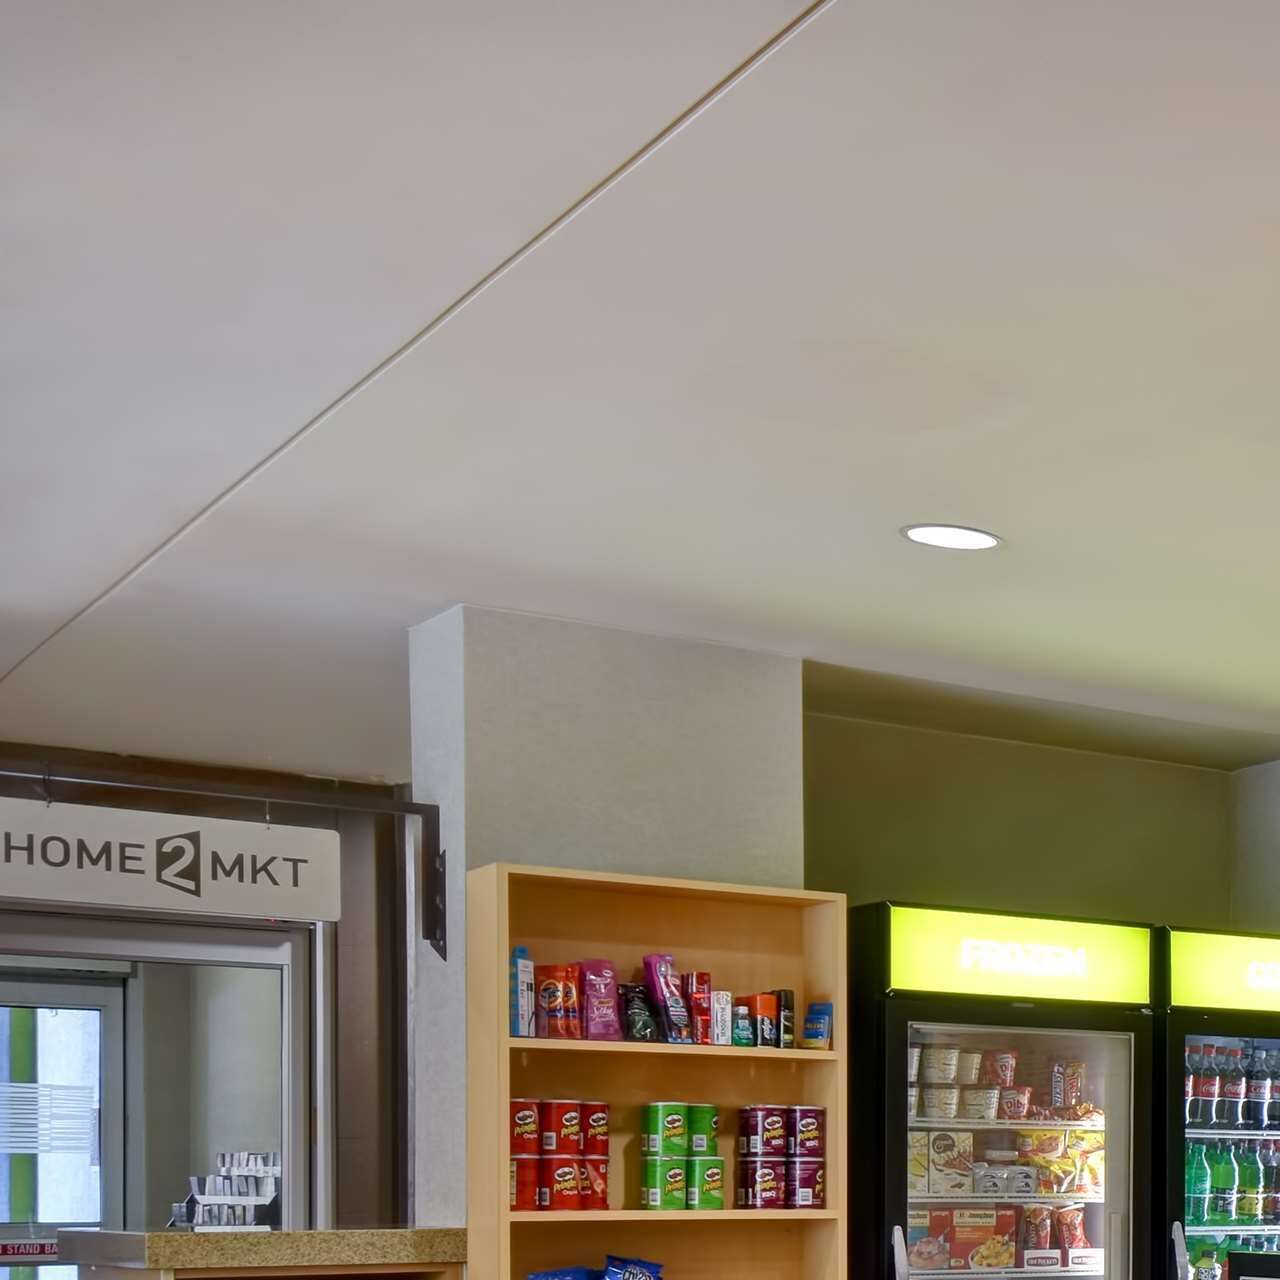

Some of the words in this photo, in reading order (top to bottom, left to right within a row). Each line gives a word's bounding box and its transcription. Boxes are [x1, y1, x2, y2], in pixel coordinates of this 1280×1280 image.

[4, 831, 146, 875] HOME
[158, 834, 198, 893] 2
[211, 853, 309, 889] MKT
